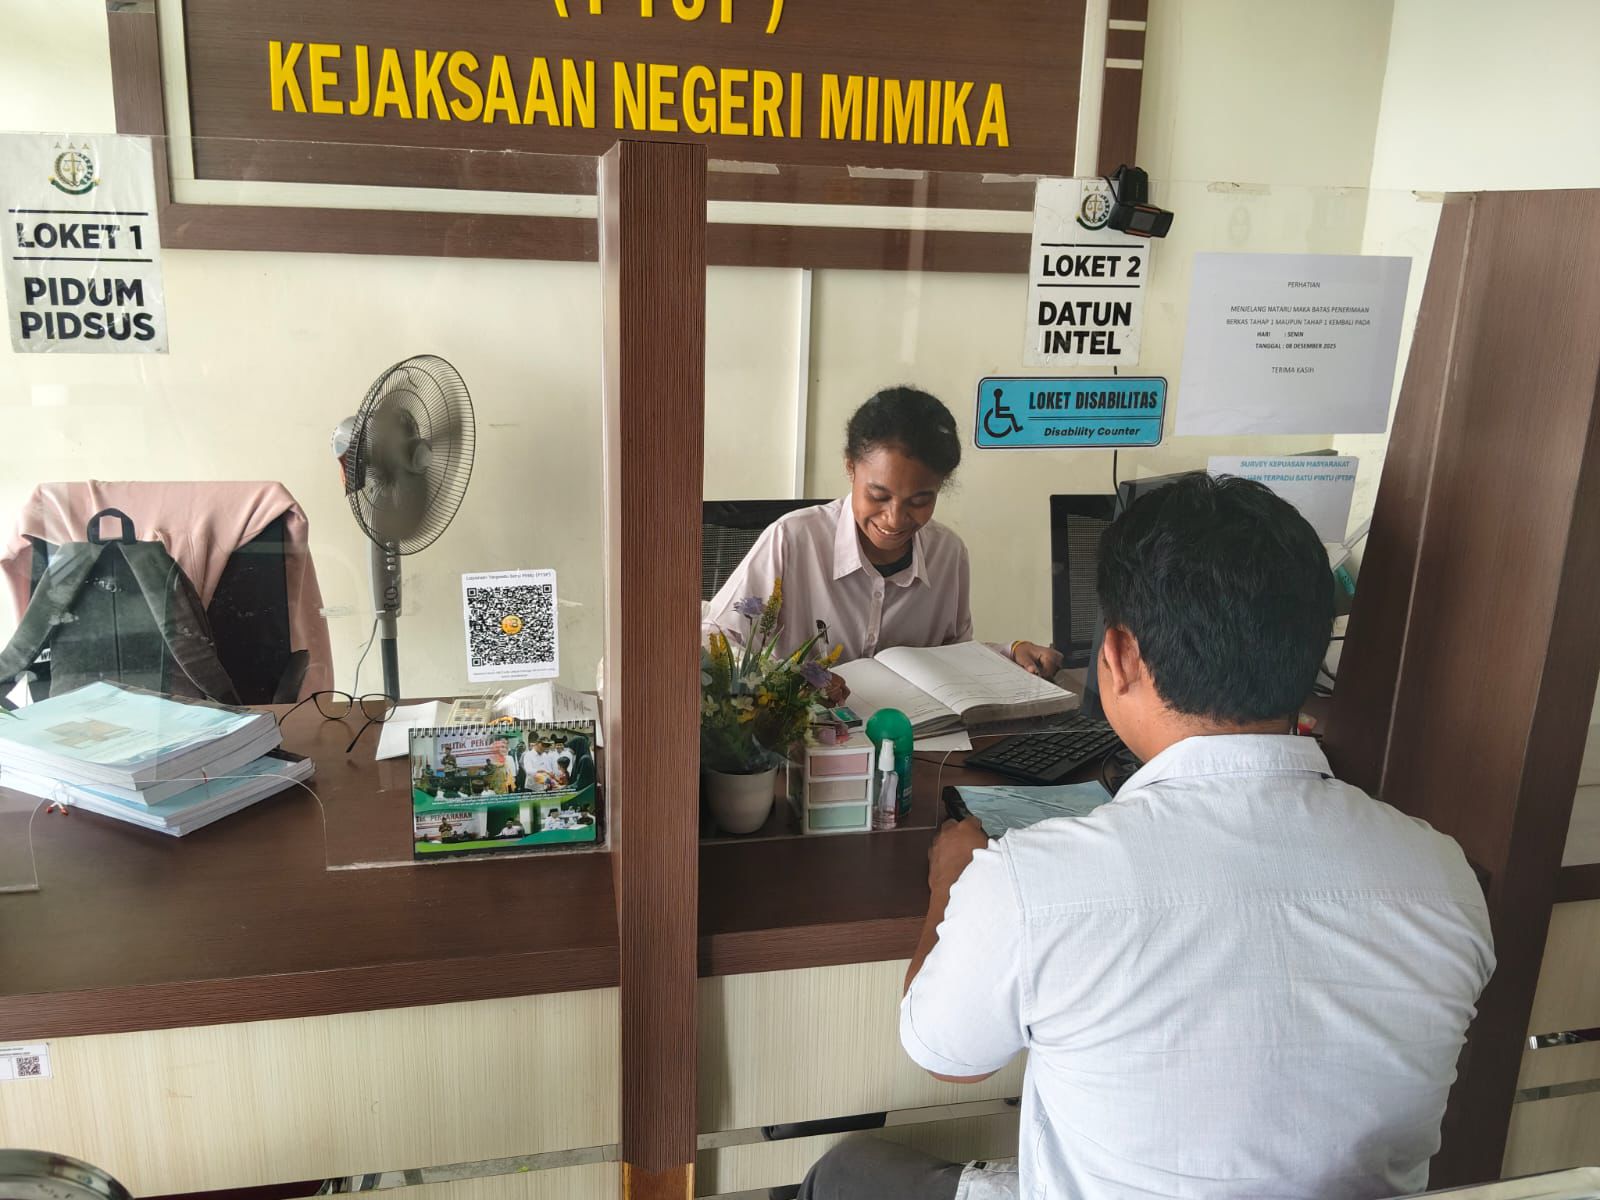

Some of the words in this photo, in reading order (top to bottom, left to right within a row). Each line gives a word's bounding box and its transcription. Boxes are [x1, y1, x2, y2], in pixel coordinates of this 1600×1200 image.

[269, 41, 596, 129] KEJAKSAAN
[614, 61, 802, 138] NEGERI
[820, 73, 1010, 147] MIMIKA
[16, 222, 121, 249] LOKET
[129, 225, 143, 250] 1
[1042, 254, 1121, 277] LOKET
[1126, 255, 1141, 278] 2
[24, 276, 145, 307] PIDUM
[1287, 281, 1321, 289] PERHATIAN
[1038, 301, 1132, 327] DATUN
[1230, 305, 1267, 313] MENJELANG
[1331, 306, 1370, 314] PENERIMAAN
[20, 311, 156, 341] PIDSUS
[1043, 330, 1122, 355] INTEL
[1271, 366, 1296, 374] TERIMA
[1028, 391, 1071, 410] LOKET
[1075, 391, 1158, 410] DISABILITAS
[1043, 426, 1094, 438] Disability
[1097, 426, 1141, 437] Counter
[1240, 460, 1267, 468] SURVEY
[1268, 460, 1305, 468] KEPUASAN
[1306, 460, 1350, 468] MASYARAKAT
[1263, 474, 1295, 482] TERPADU
